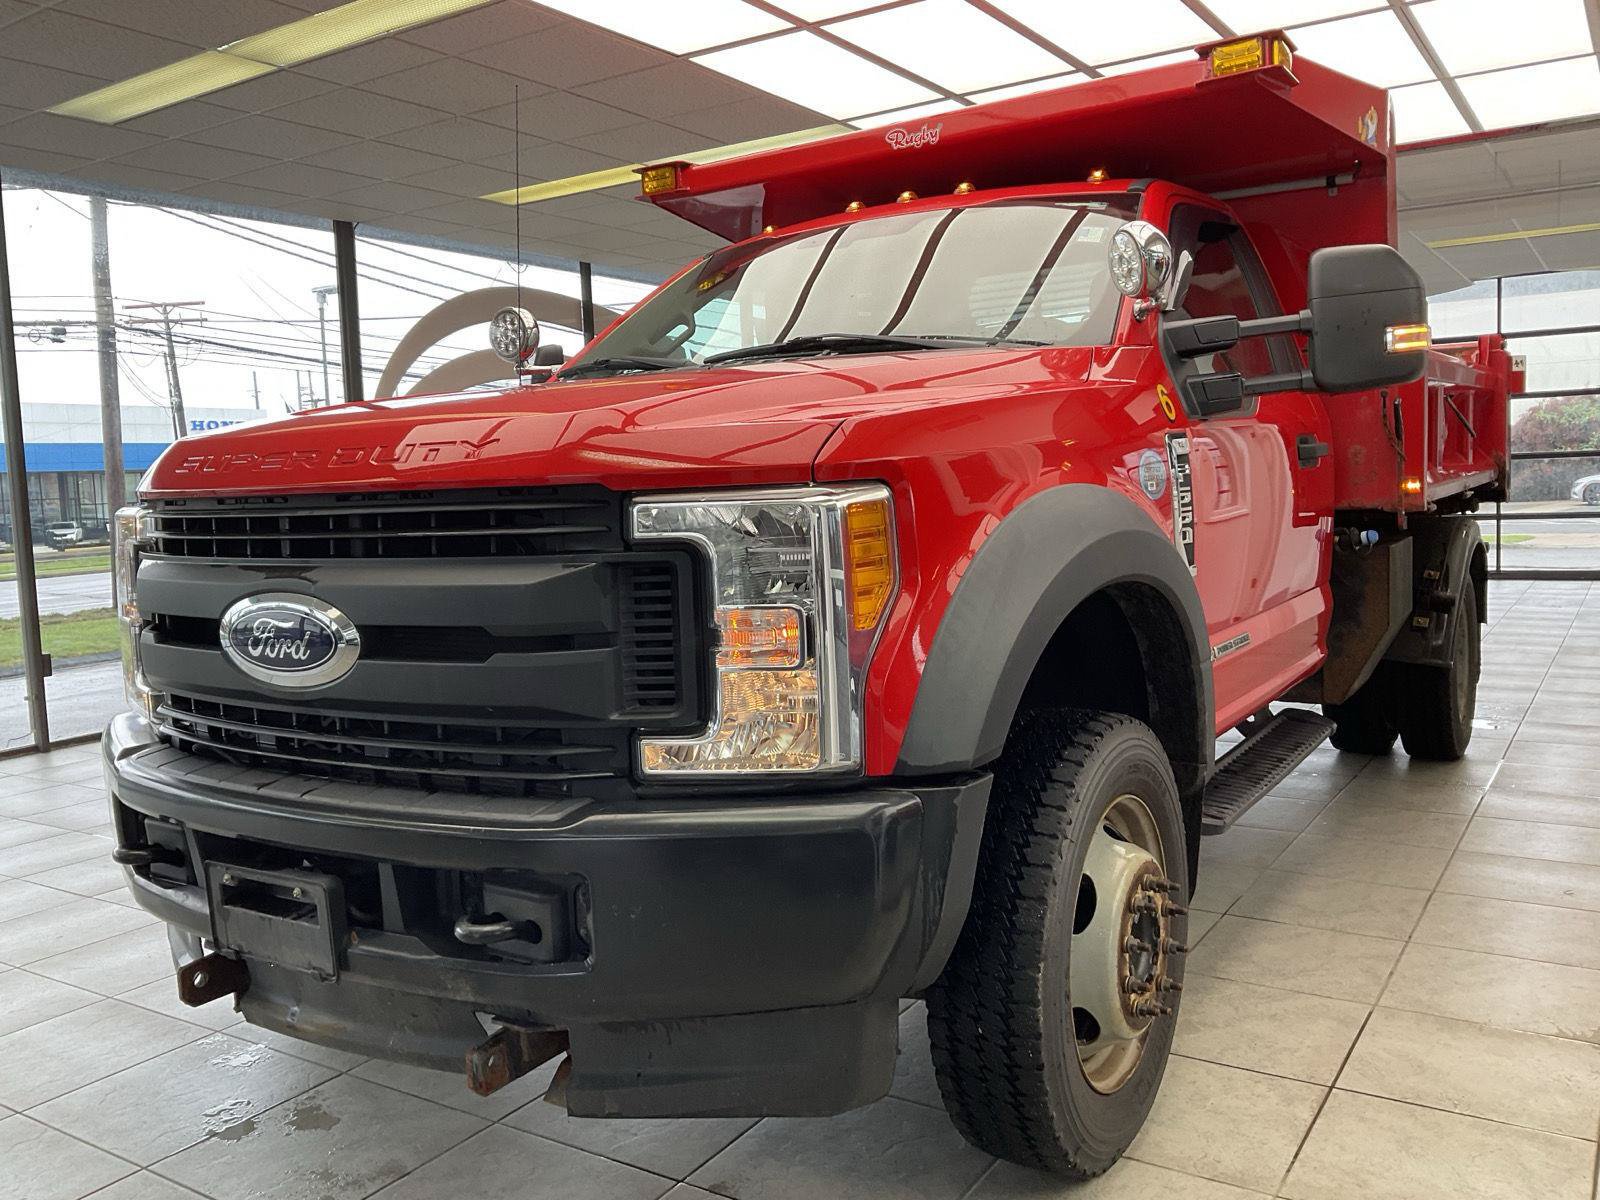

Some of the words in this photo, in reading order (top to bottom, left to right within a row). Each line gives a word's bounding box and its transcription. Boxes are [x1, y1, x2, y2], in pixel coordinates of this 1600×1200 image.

[885, 124, 941, 150] Rugby
[1157, 384, 1176, 422] 6
[191, 420, 245, 431] HON
[174, 449, 318, 473] SUPER
[327, 438, 501, 468] DUTY
[247, 617, 311, 660] Ford
